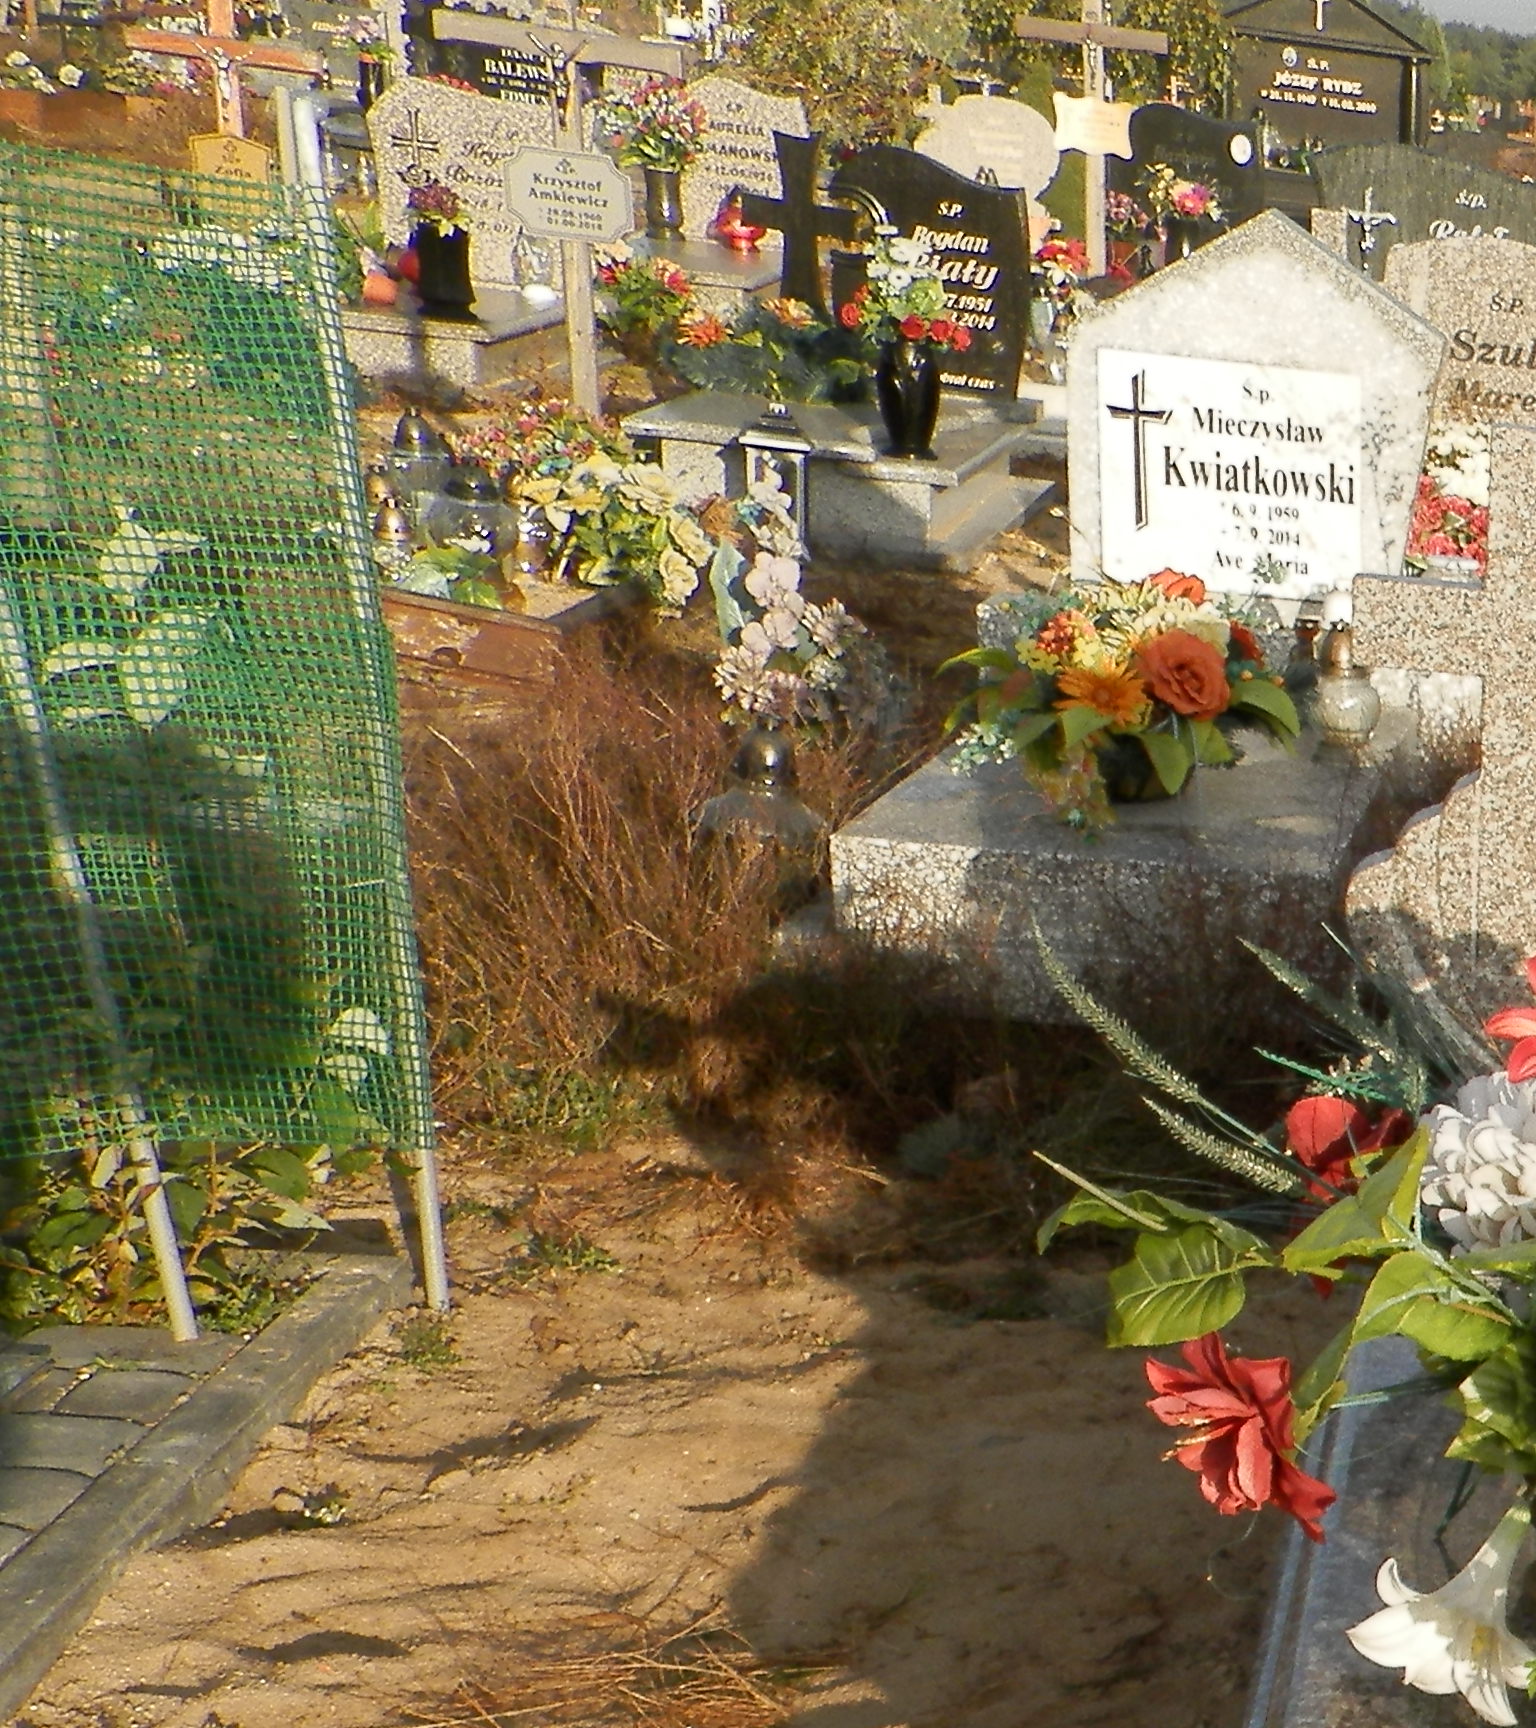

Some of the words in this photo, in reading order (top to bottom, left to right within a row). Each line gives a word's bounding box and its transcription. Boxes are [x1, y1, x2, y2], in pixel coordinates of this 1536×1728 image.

[484, 58, 552, 82] BALEWS
[709, 120, 764, 137] AURELIA
[533, 172, 602, 193] Krzysztof
[912, 225, 989, 255] Bogdan
[1192, 406, 1324, 447] Mieczysław
[1163, 445, 1355, 505] Kwiatkowski
[1268, 506, 1300, 522] 1959
[1268, 528, 1301, 547] 2014
[1216, 550, 1244, 569] Ave
